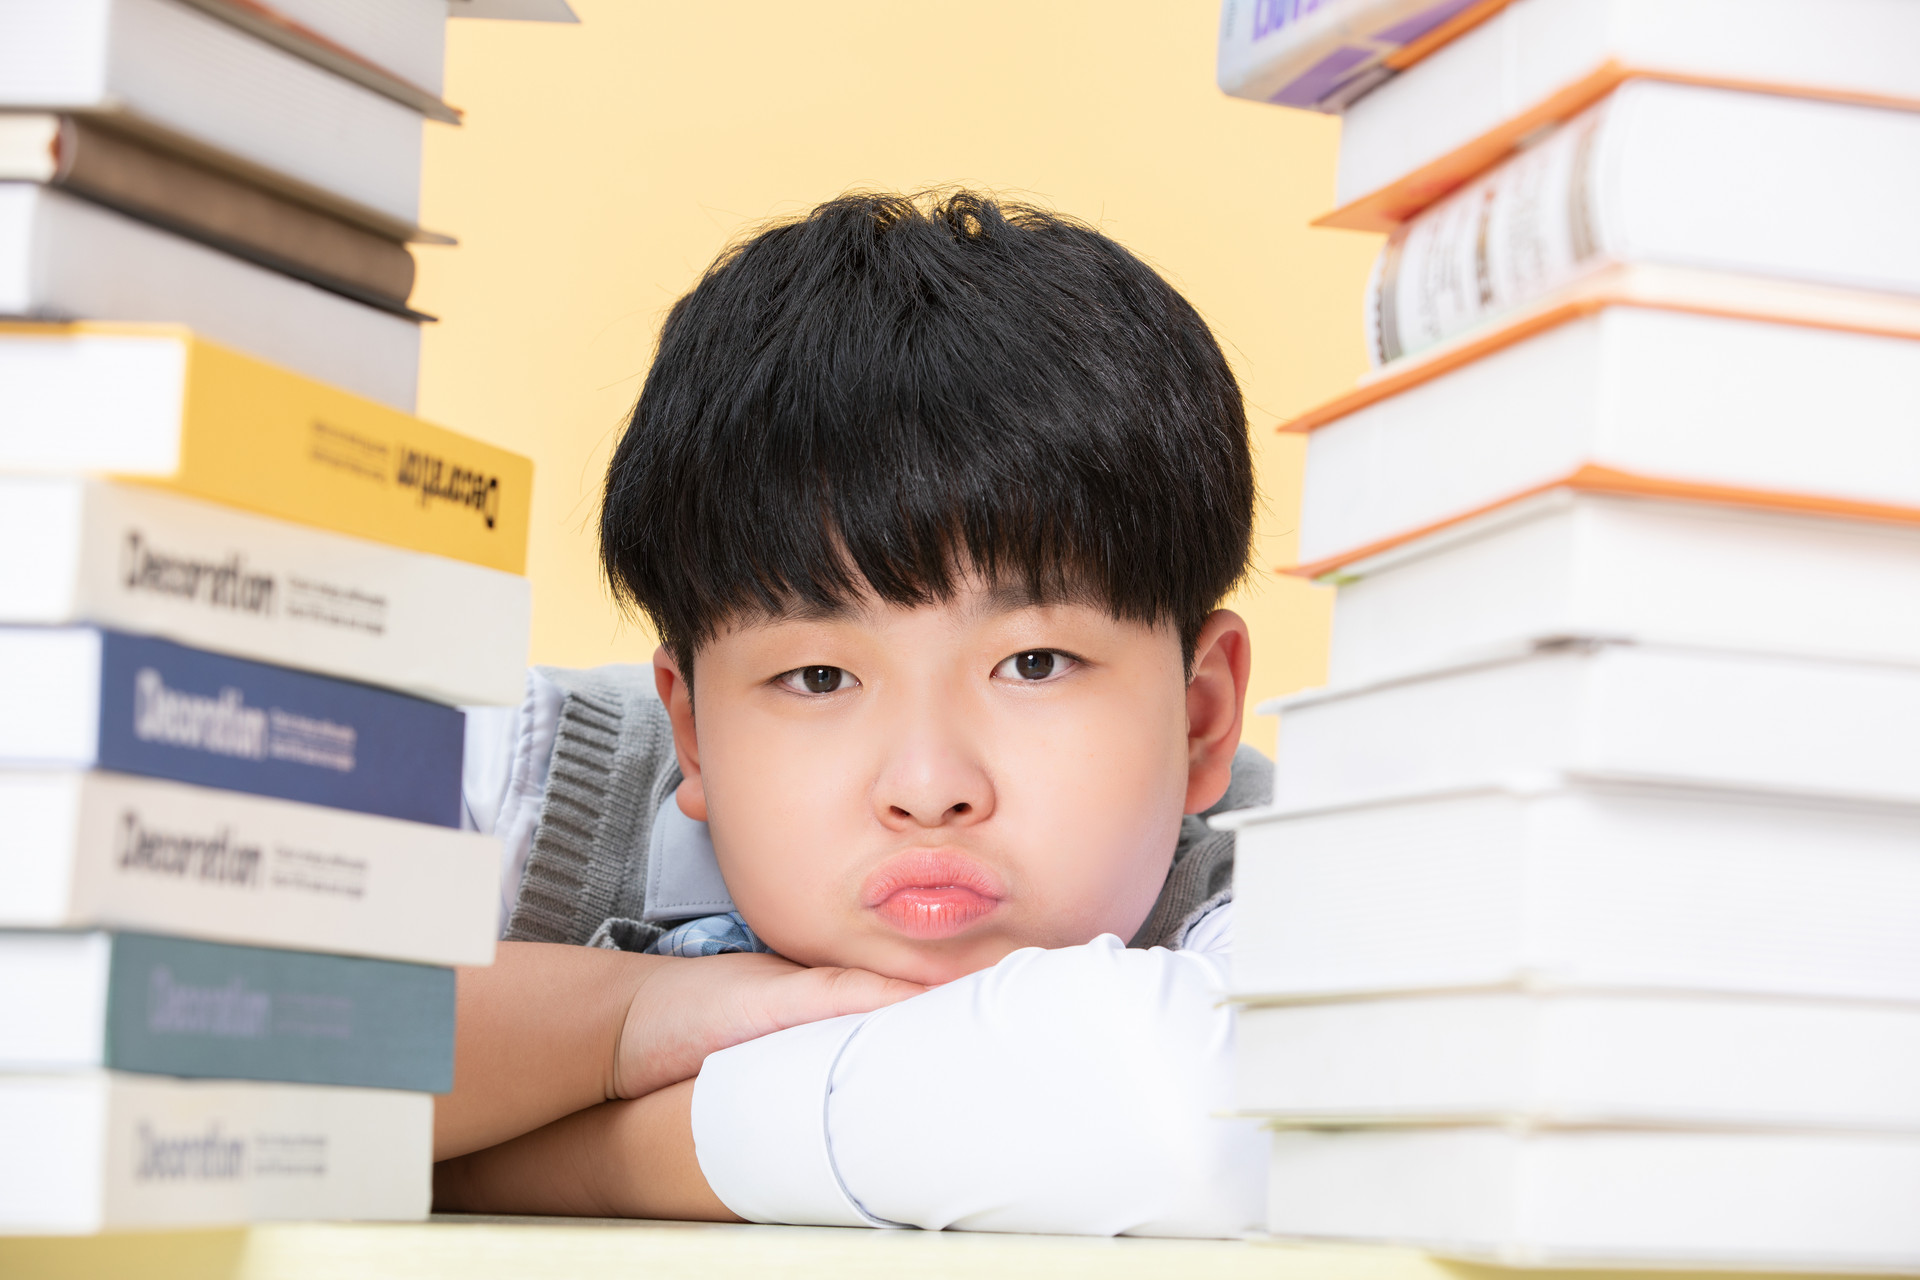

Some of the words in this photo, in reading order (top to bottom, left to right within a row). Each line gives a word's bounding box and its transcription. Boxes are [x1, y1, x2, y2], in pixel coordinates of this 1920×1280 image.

[394, 445, 501, 531] Decoration
[122, 531, 276, 616] Decoration
[132, 667, 267, 762] Decoration
[117, 808, 264, 891] Decoration
